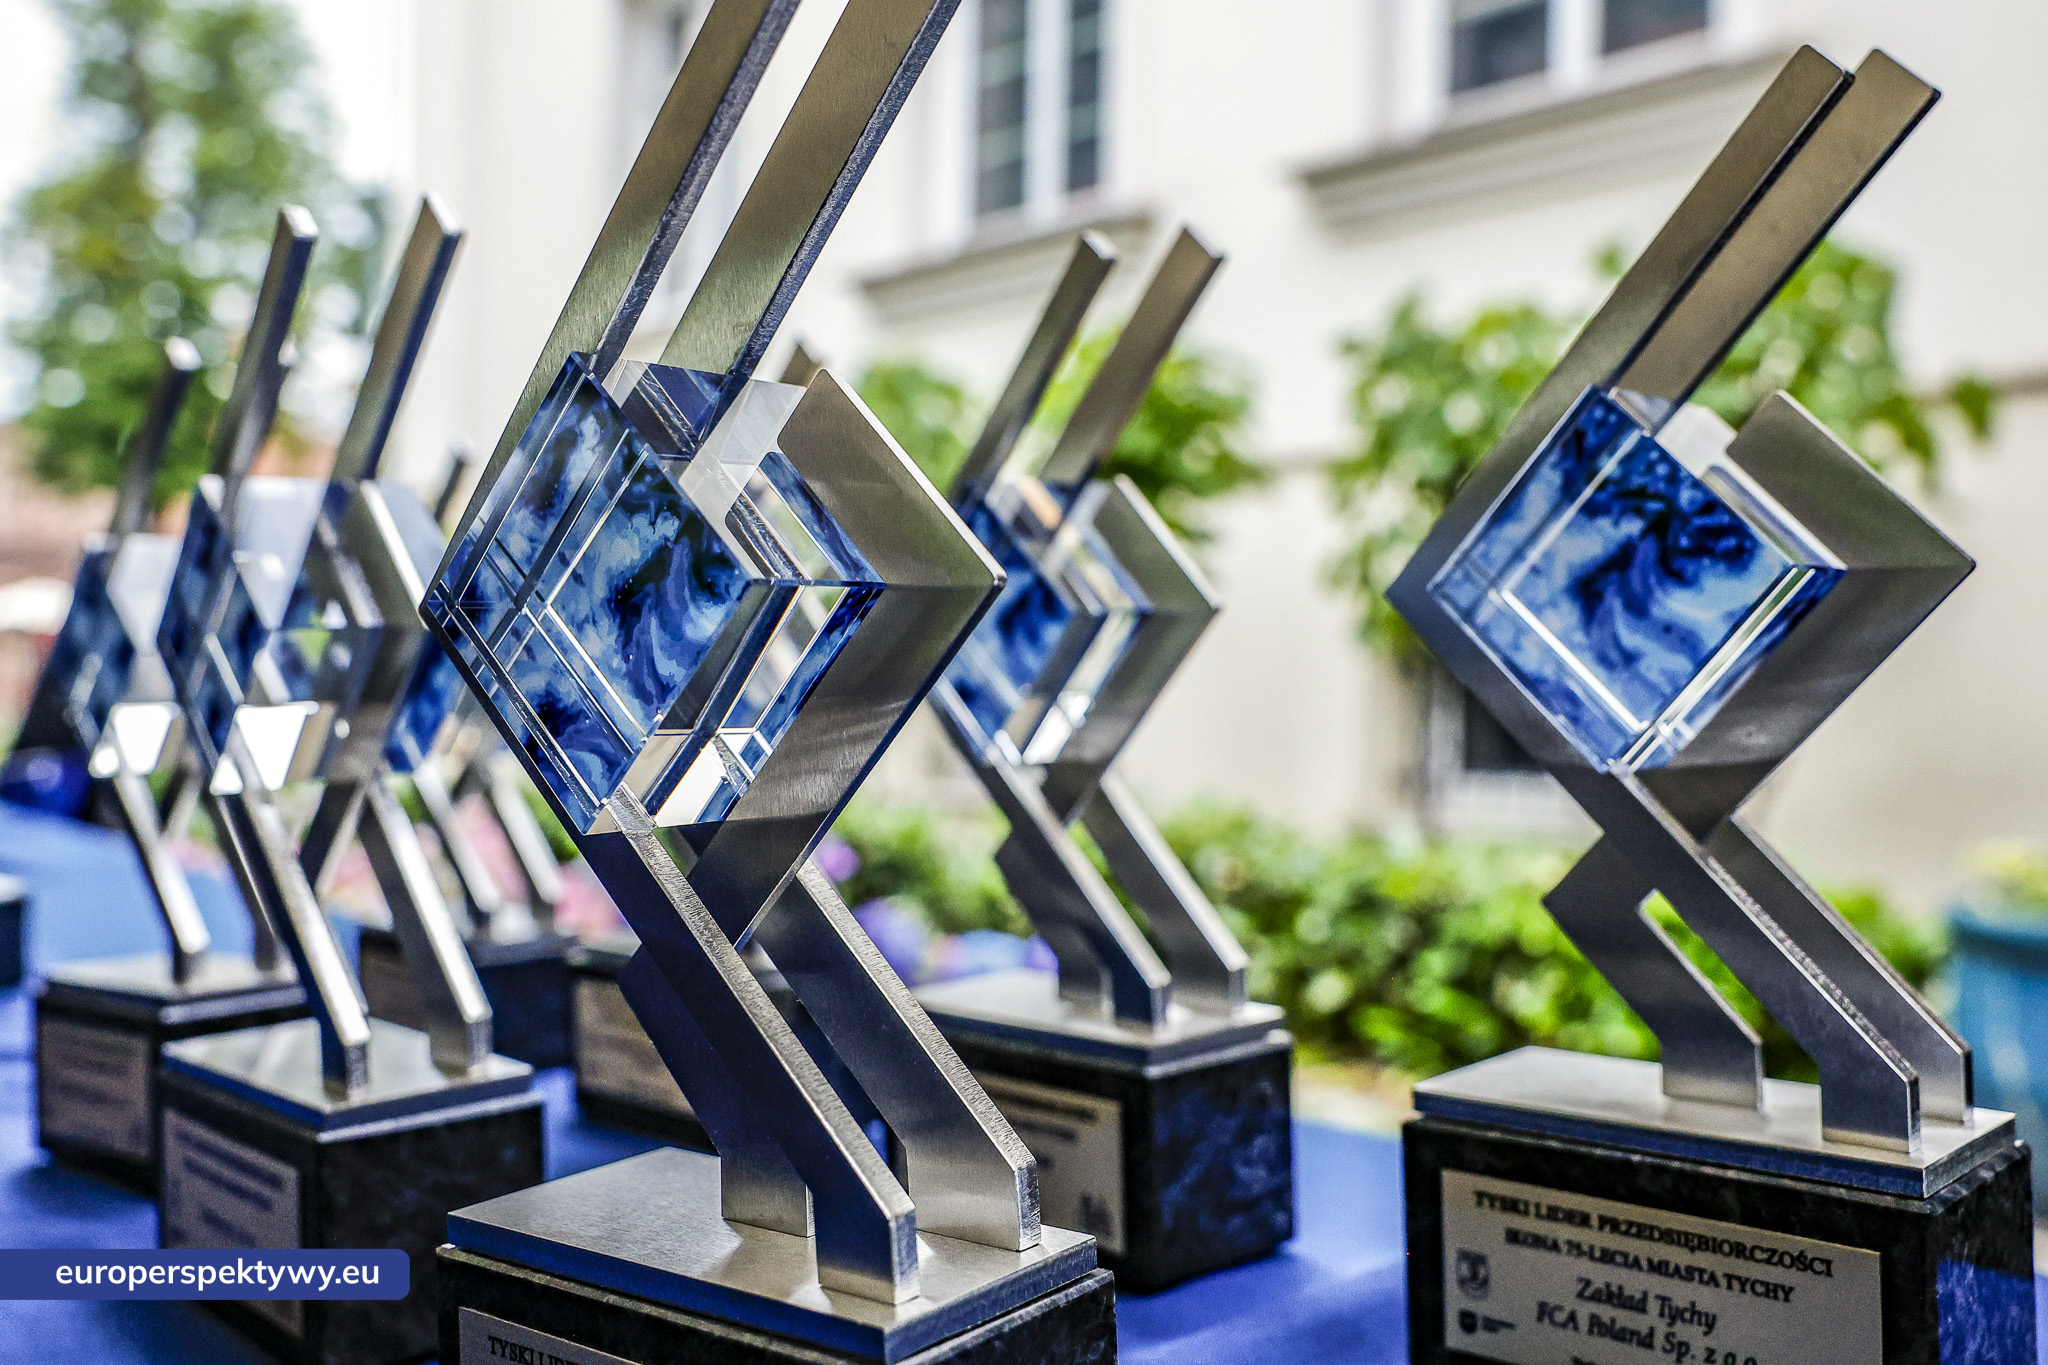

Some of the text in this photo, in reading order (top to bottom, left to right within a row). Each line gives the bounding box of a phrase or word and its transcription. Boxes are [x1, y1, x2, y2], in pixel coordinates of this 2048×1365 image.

[1473, 1189, 1834, 1278] TYSKI LIDER PRZEDSIĘBIORCZOŚCI
[1645, 1255, 1721, 1289] MIASTA
[1722, 1271, 1796, 1304] TYCHY
[1536, 1300, 1580, 1334] FCA
[1587, 1311, 1656, 1351] Poland
[1661, 1330, 1697, 1365] Sp.
[1654, 1294, 1718, 1337] Tychy
[487, 1335, 535, 1365] TYSKI
